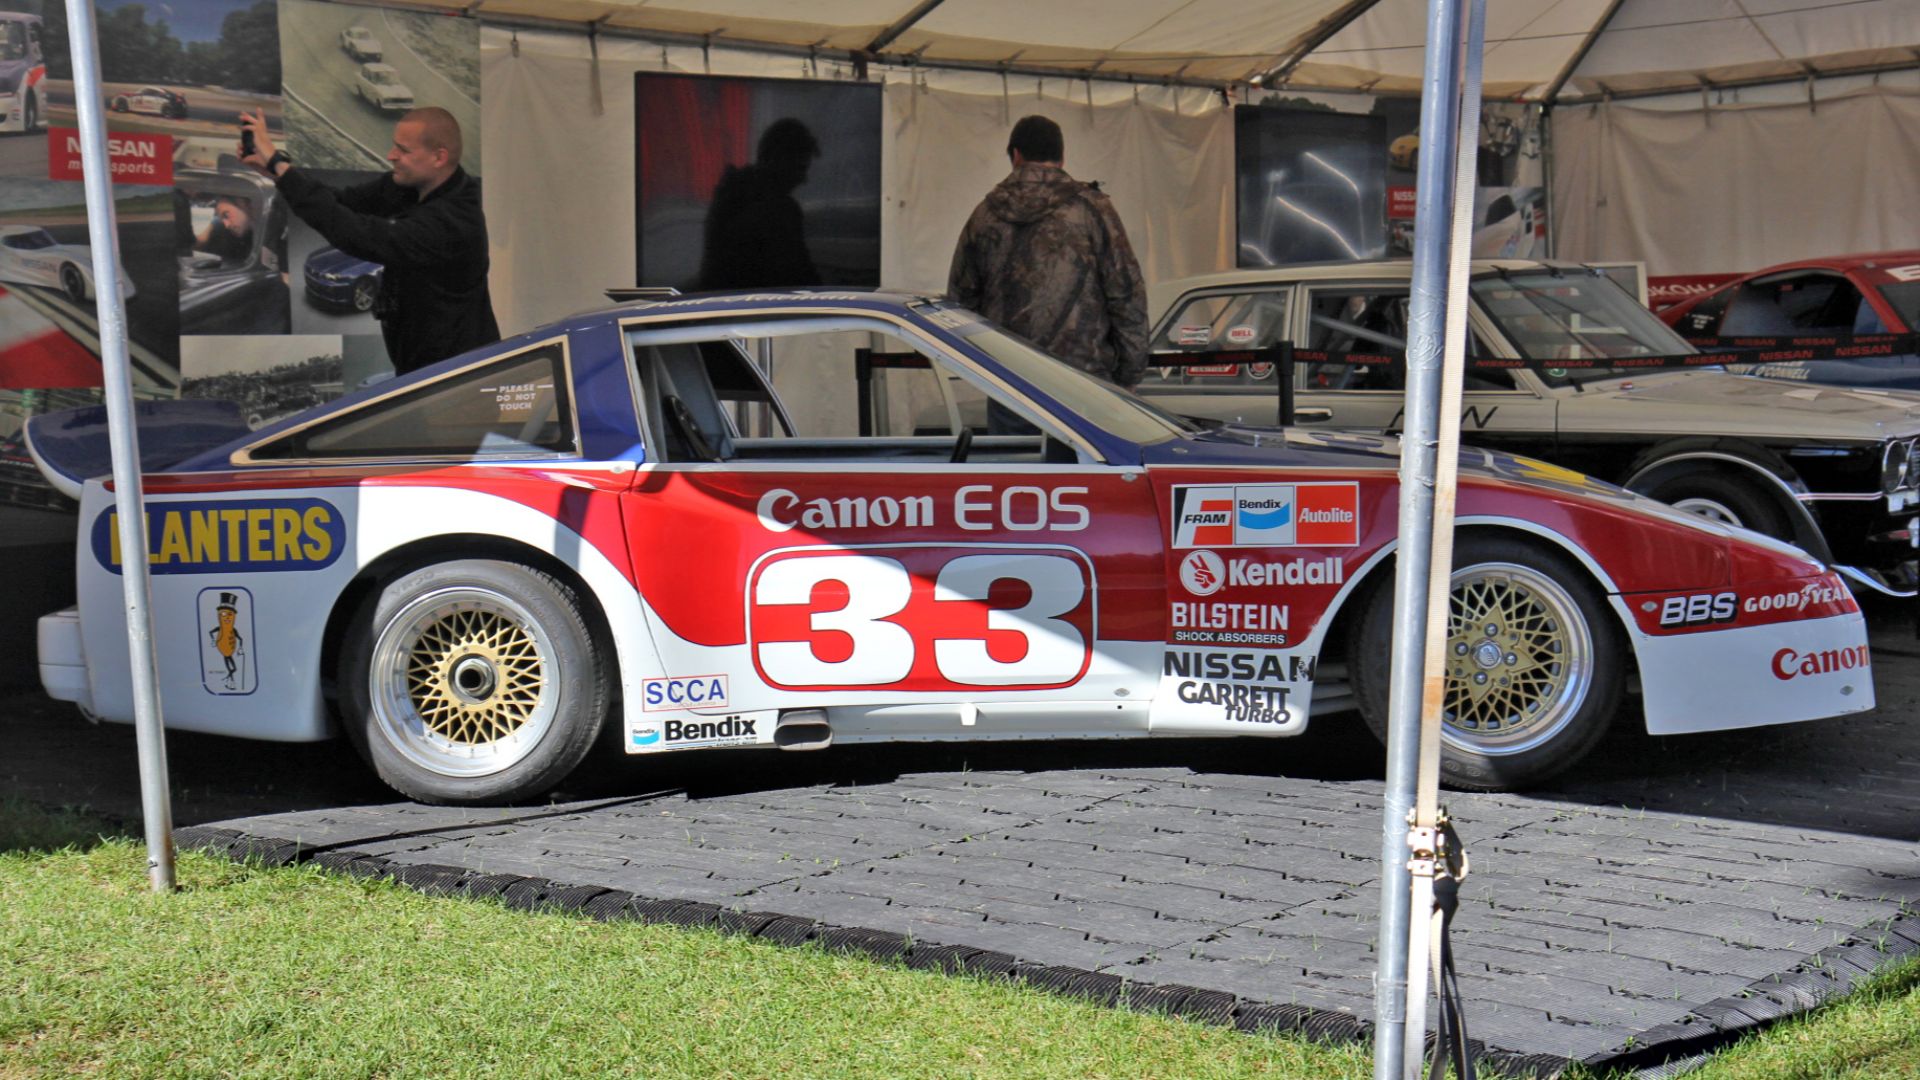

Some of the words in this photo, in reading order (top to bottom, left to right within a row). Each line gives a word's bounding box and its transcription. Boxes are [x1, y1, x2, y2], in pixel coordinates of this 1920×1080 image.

[66, 137, 155, 158] NSAN
[68, 159, 155, 175] msports
[1231, 328, 1253, 337] BELL
[1344, 354, 1393, 364] NISSAN
[1475, 360, 1525, 368] NISSAN
[1543, 360, 1593, 368] NISSAN
[1613, 358, 1665, 367] NISSAN
[1684, 354, 1738, 365] NISSAN
[1758, 349, 1813, 361] NISSAN
[1834, 344, 1893, 357] NISSAN
[496, 394, 511, 402] DO
[515, 392, 536, 401] NOT
[498, 383, 535, 393] PLEASE
[498, 402, 532, 411] TOUCH
[757, 488, 934, 532] Canon
[954, 485, 1090, 531] EOS
[1239, 499, 1281, 509] Bendix
[1184, 513, 1226, 524] FRAM
[1299, 507, 1353, 524] Autolite
[1229, 557, 1343, 586] Kendall
[1171, 602, 1289, 630] BILSTEIN
[1660, 592, 1738, 626] BBS
[756, 554, 1087, 686] 33
[1175, 631, 1214, 642] SHOCK
[1217, 632, 1285, 644] ABSORBERS
[1164, 651, 1316, 682] NISSAN
[1771, 644, 1869, 680] Canon
[646, 679, 725, 705] SCCA
[1178, 680, 1290, 711] GARRETT
[1225, 705, 1291, 725] TURBO
[664, 716, 756, 741] Bendix
